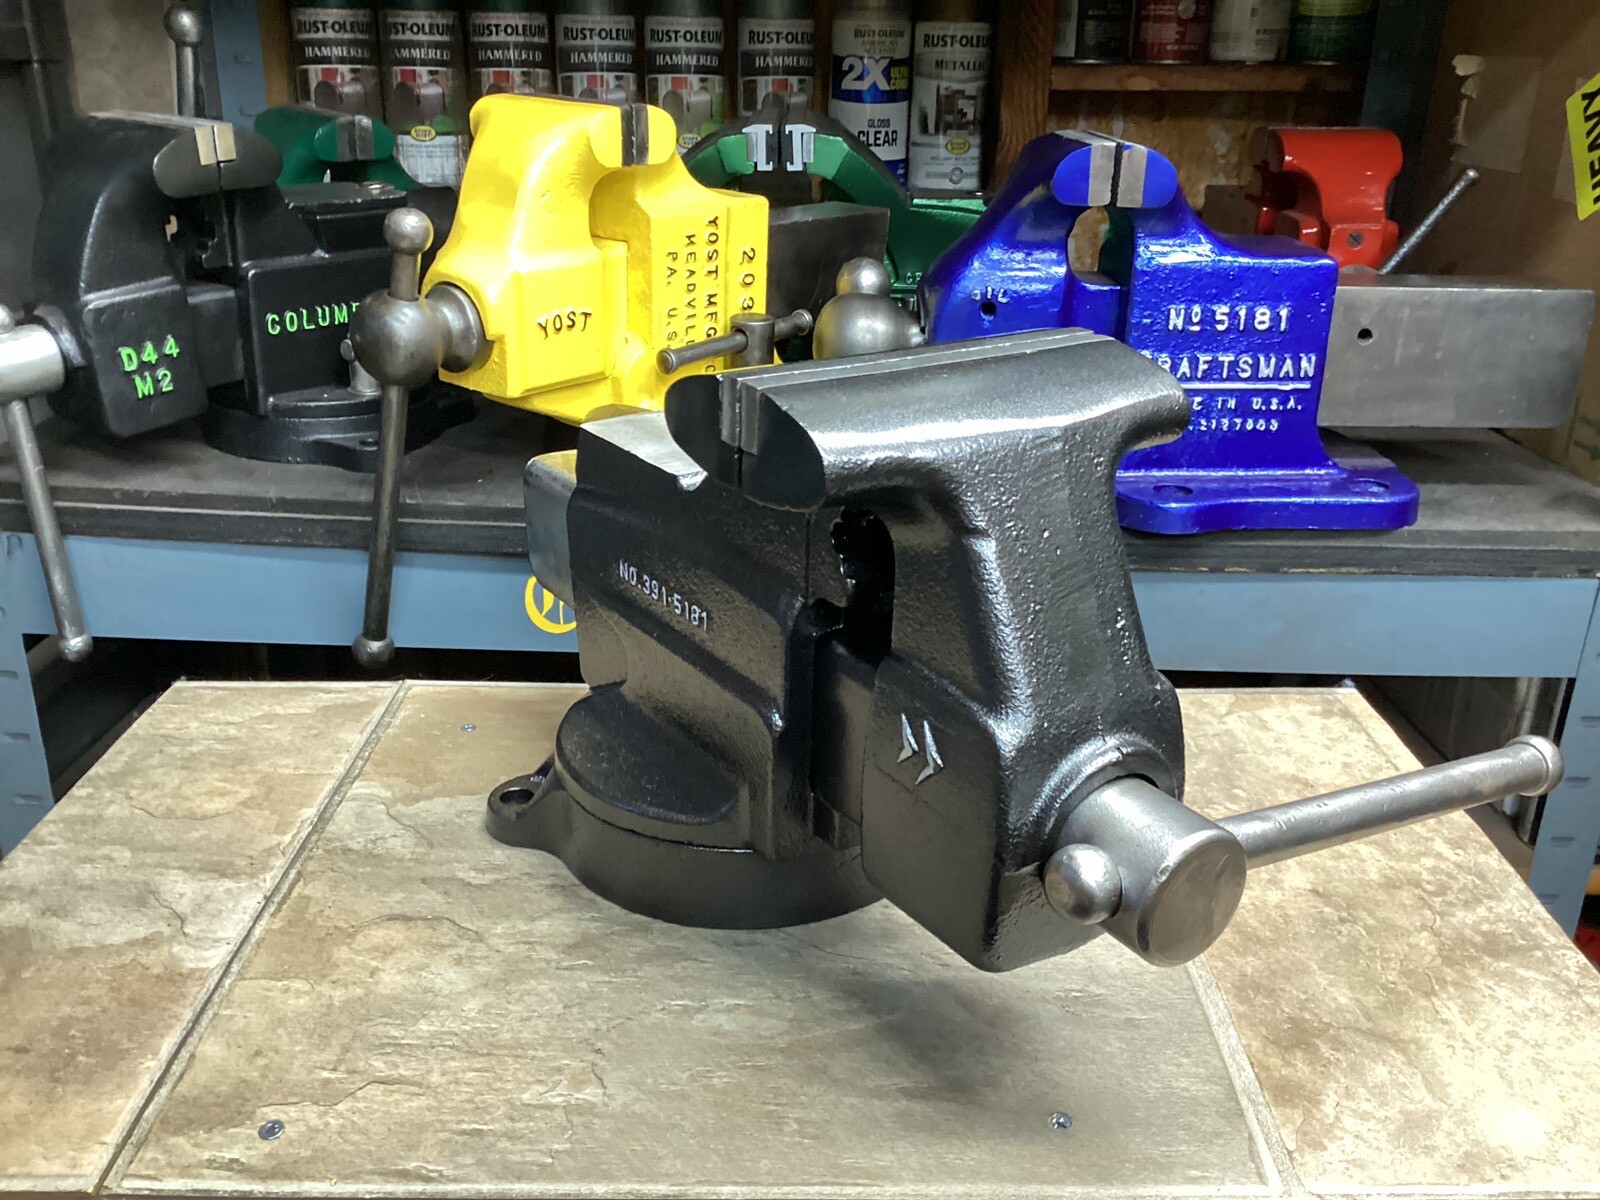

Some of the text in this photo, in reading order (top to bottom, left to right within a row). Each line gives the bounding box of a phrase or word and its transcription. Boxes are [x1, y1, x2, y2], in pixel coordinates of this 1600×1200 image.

[649, 28, 722, 44] RUST-OLEUM
[748, 29, 814, 45] RUST-OLEU
[923, 33, 989, 48] RUST-OLEU
[304, 46, 371, 58] HAMMERED
[394, 47, 451, 60] AMMERED
[478, 49, 543, 61] HAMMERED
[570, 51, 633, 64] HAMMERED
[656, 53, 719, 67] HAMMERED
[841, 55, 893, 91] 2X
[867, 118, 891, 129] GLOSS
[857, 130, 898, 147] CLEAR
[706, 216, 719, 280] YOST
[740, 247, 756, 312] 203
[684, 233, 697, 347] MEADVILL
[971, 286, 1010, 303] OIL
[666, 252, 679, 348] PA. U.S.
[536, 310, 592, 340] YOST
[1213, 305, 1291, 332] 5181
[118, 335, 180, 372] D44
[1141, 350, 1316, 379] RAFTSMAN
[133, 367, 174, 399] M2
[1252, 396, 1302, 411] U.S.A.
